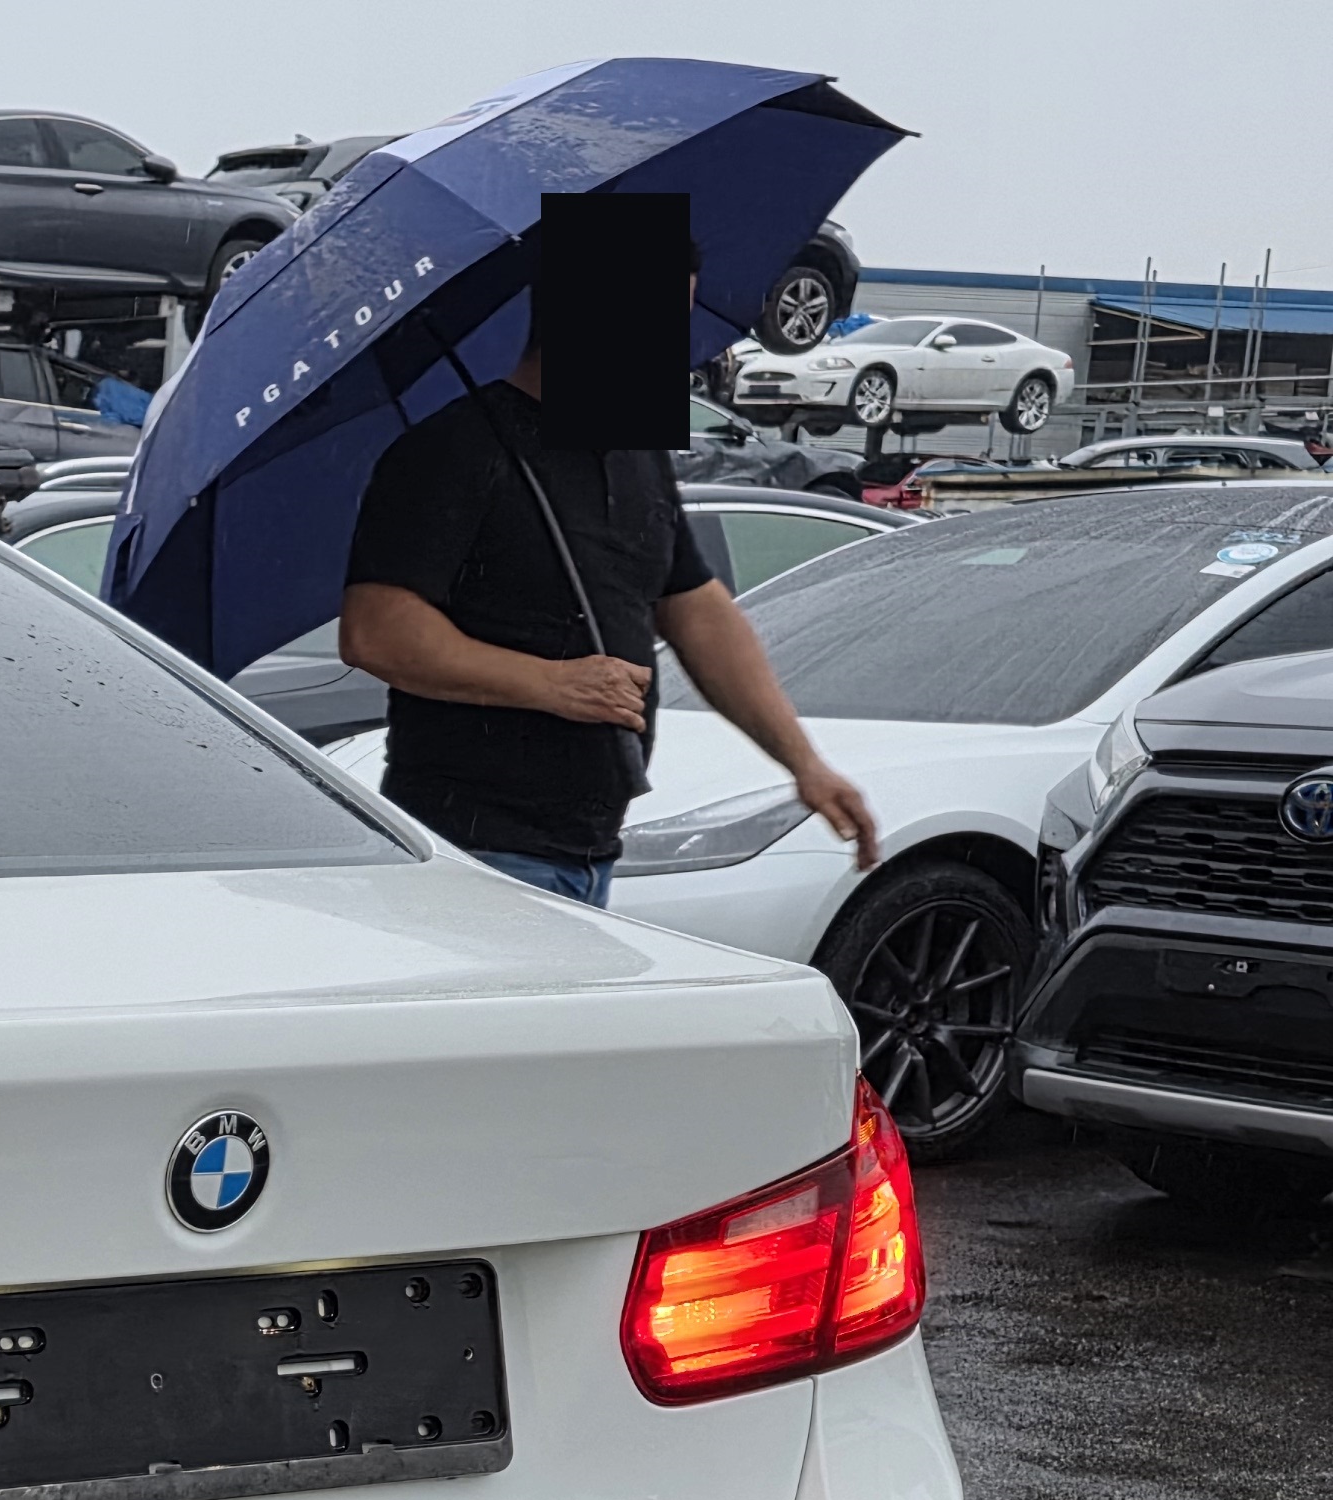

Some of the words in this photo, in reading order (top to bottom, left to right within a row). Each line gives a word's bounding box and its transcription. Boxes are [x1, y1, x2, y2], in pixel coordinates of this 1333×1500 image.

[235, 360, 311, 428] PGA
[324, 256, 434, 348] TOUR
[184, 1114, 267, 1156] BMW
